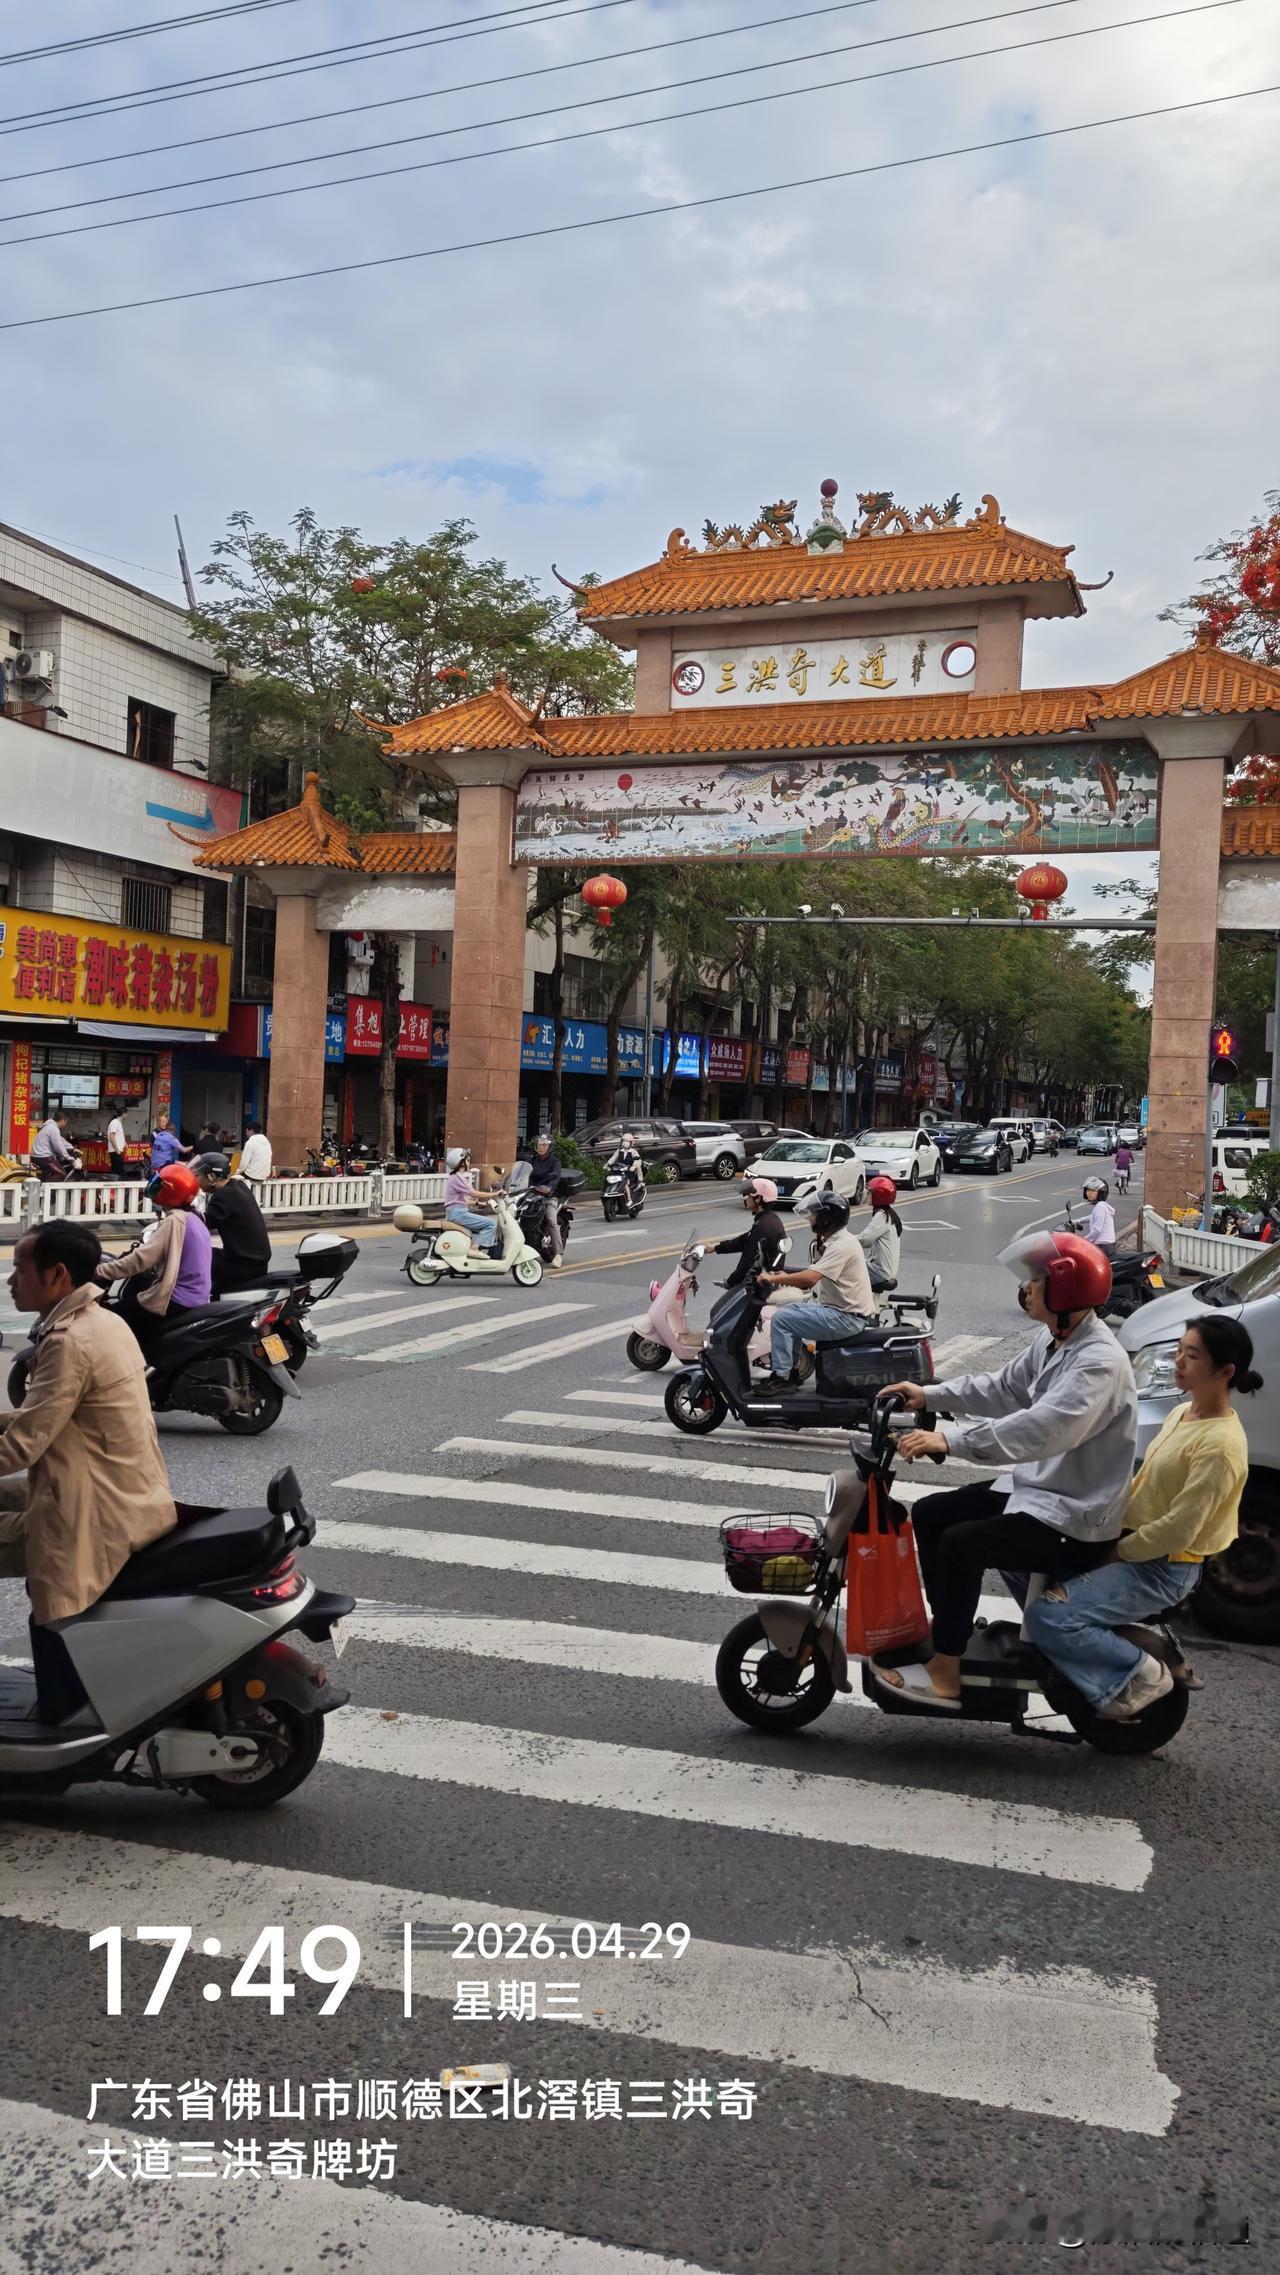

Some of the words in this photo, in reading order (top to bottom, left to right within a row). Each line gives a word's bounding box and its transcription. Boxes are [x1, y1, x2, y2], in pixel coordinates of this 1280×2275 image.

[715, 643, 897, 696] 三洪奇大道
[16, 925, 78, 968] 美尚惠
[14, 963, 77, 1003] 便利店
[13, 1043, 29, 1126] 枸杞猪杂汤饭
